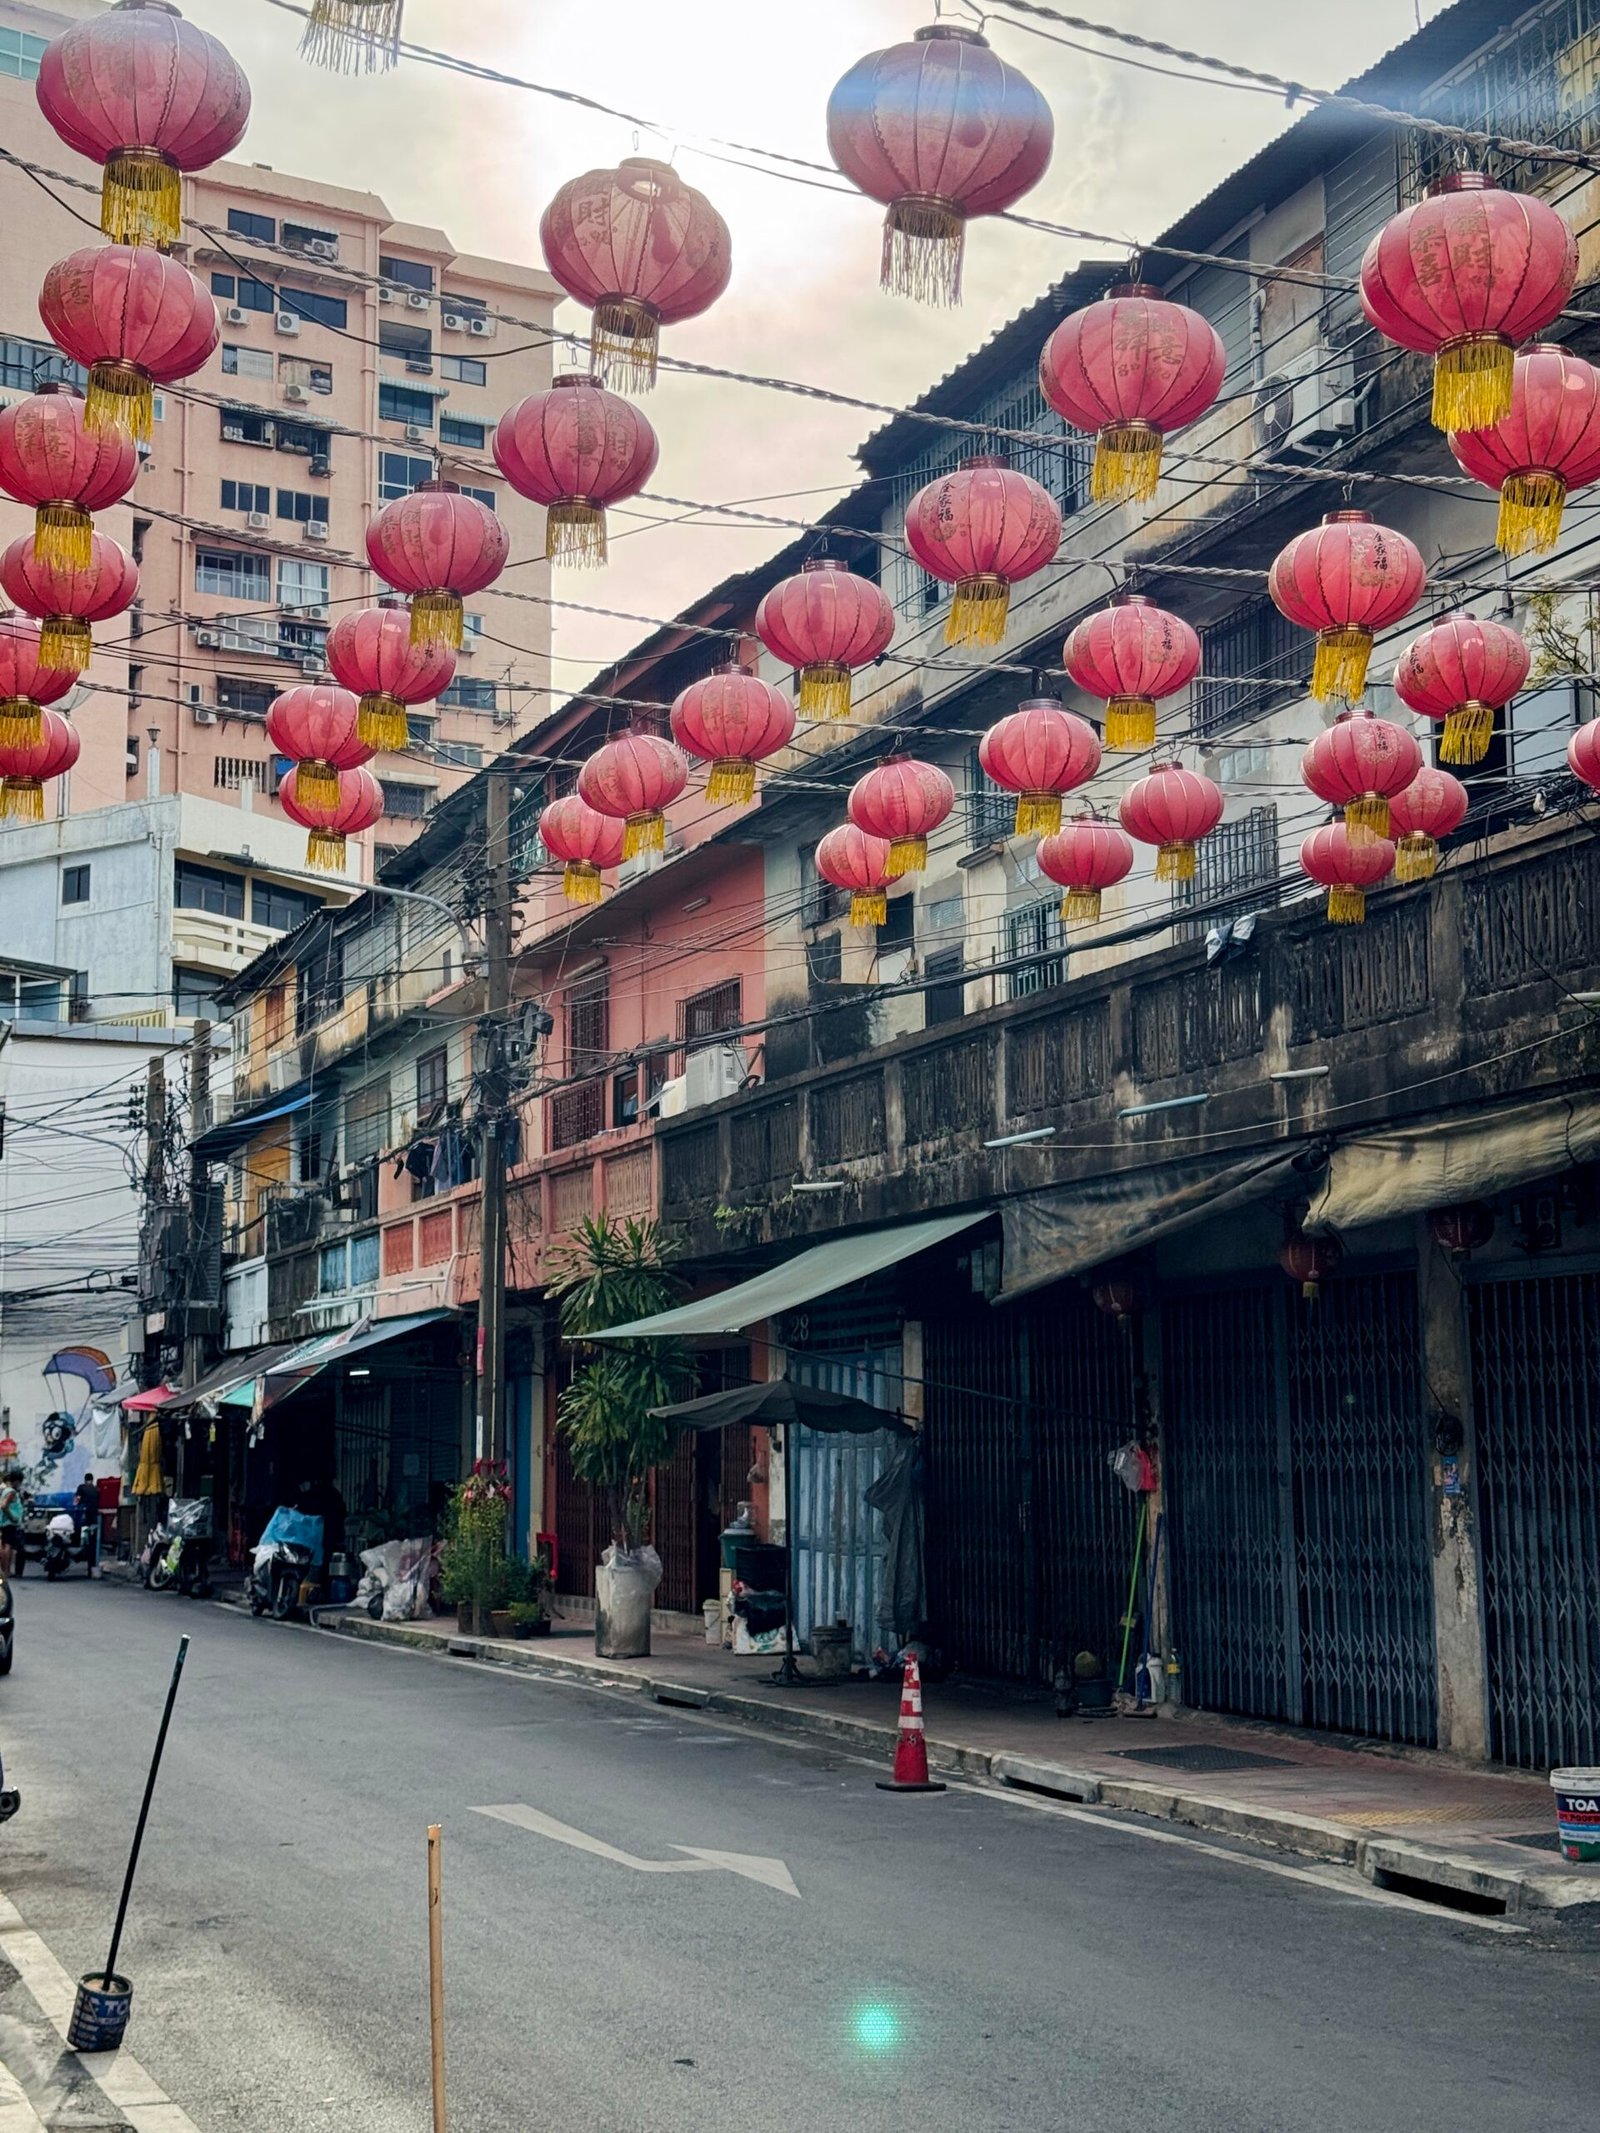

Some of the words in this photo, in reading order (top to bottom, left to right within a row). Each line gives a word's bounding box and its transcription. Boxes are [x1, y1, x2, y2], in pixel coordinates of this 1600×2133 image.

[937, 482, 955, 522] 全家福
[1372, 532, 1388, 571] 全家福
[1565, 1798, 1599, 1812] TOA
